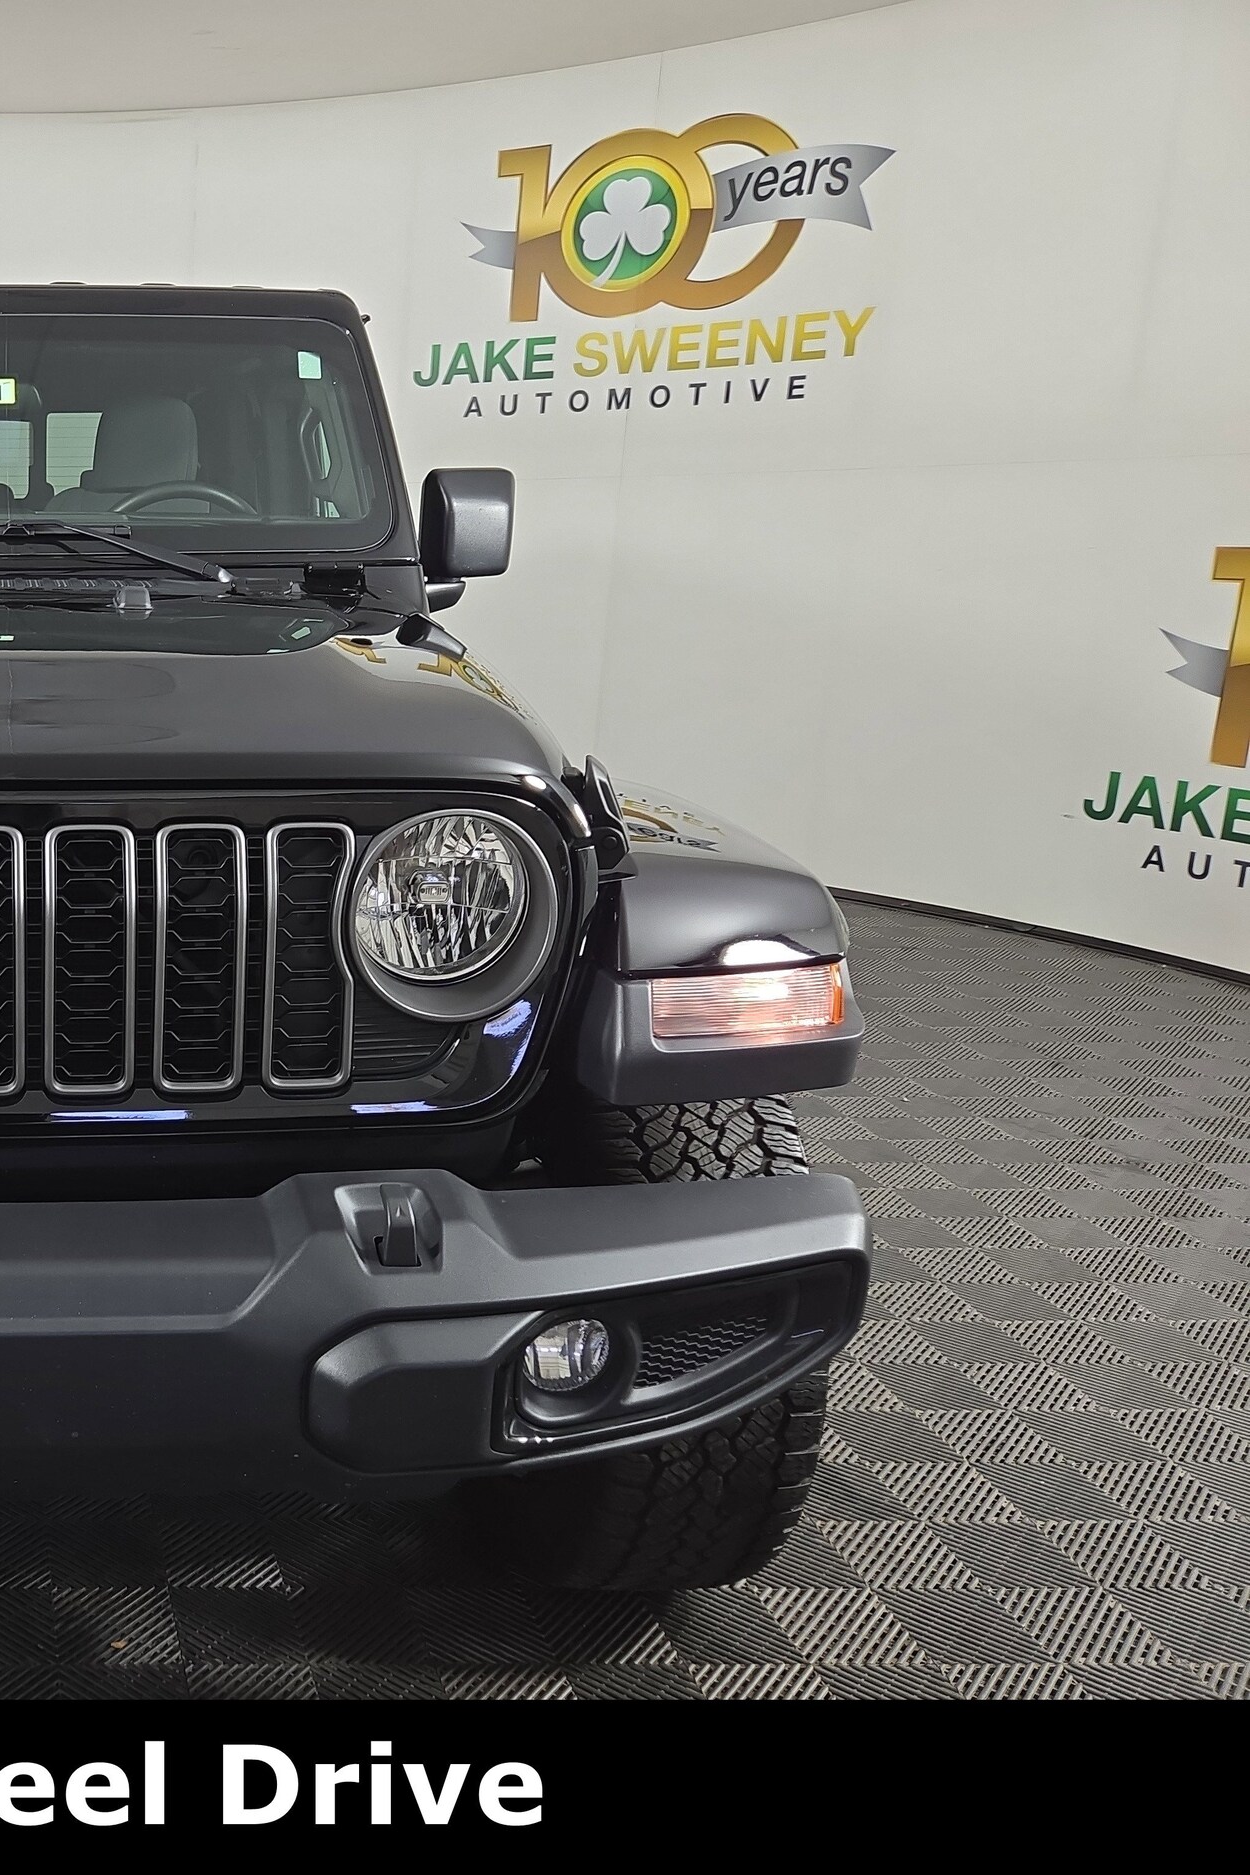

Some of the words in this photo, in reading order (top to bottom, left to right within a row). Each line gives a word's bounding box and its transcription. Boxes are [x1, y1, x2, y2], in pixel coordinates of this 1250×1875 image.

[723, 155, 852, 222] years
[413, 335, 556, 387] JAKE
[573, 307, 877, 378] SWEENEY
[464, 375, 807, 418] AUTOMOTIVE
[1083, 771, 1250, 845] JAKE
